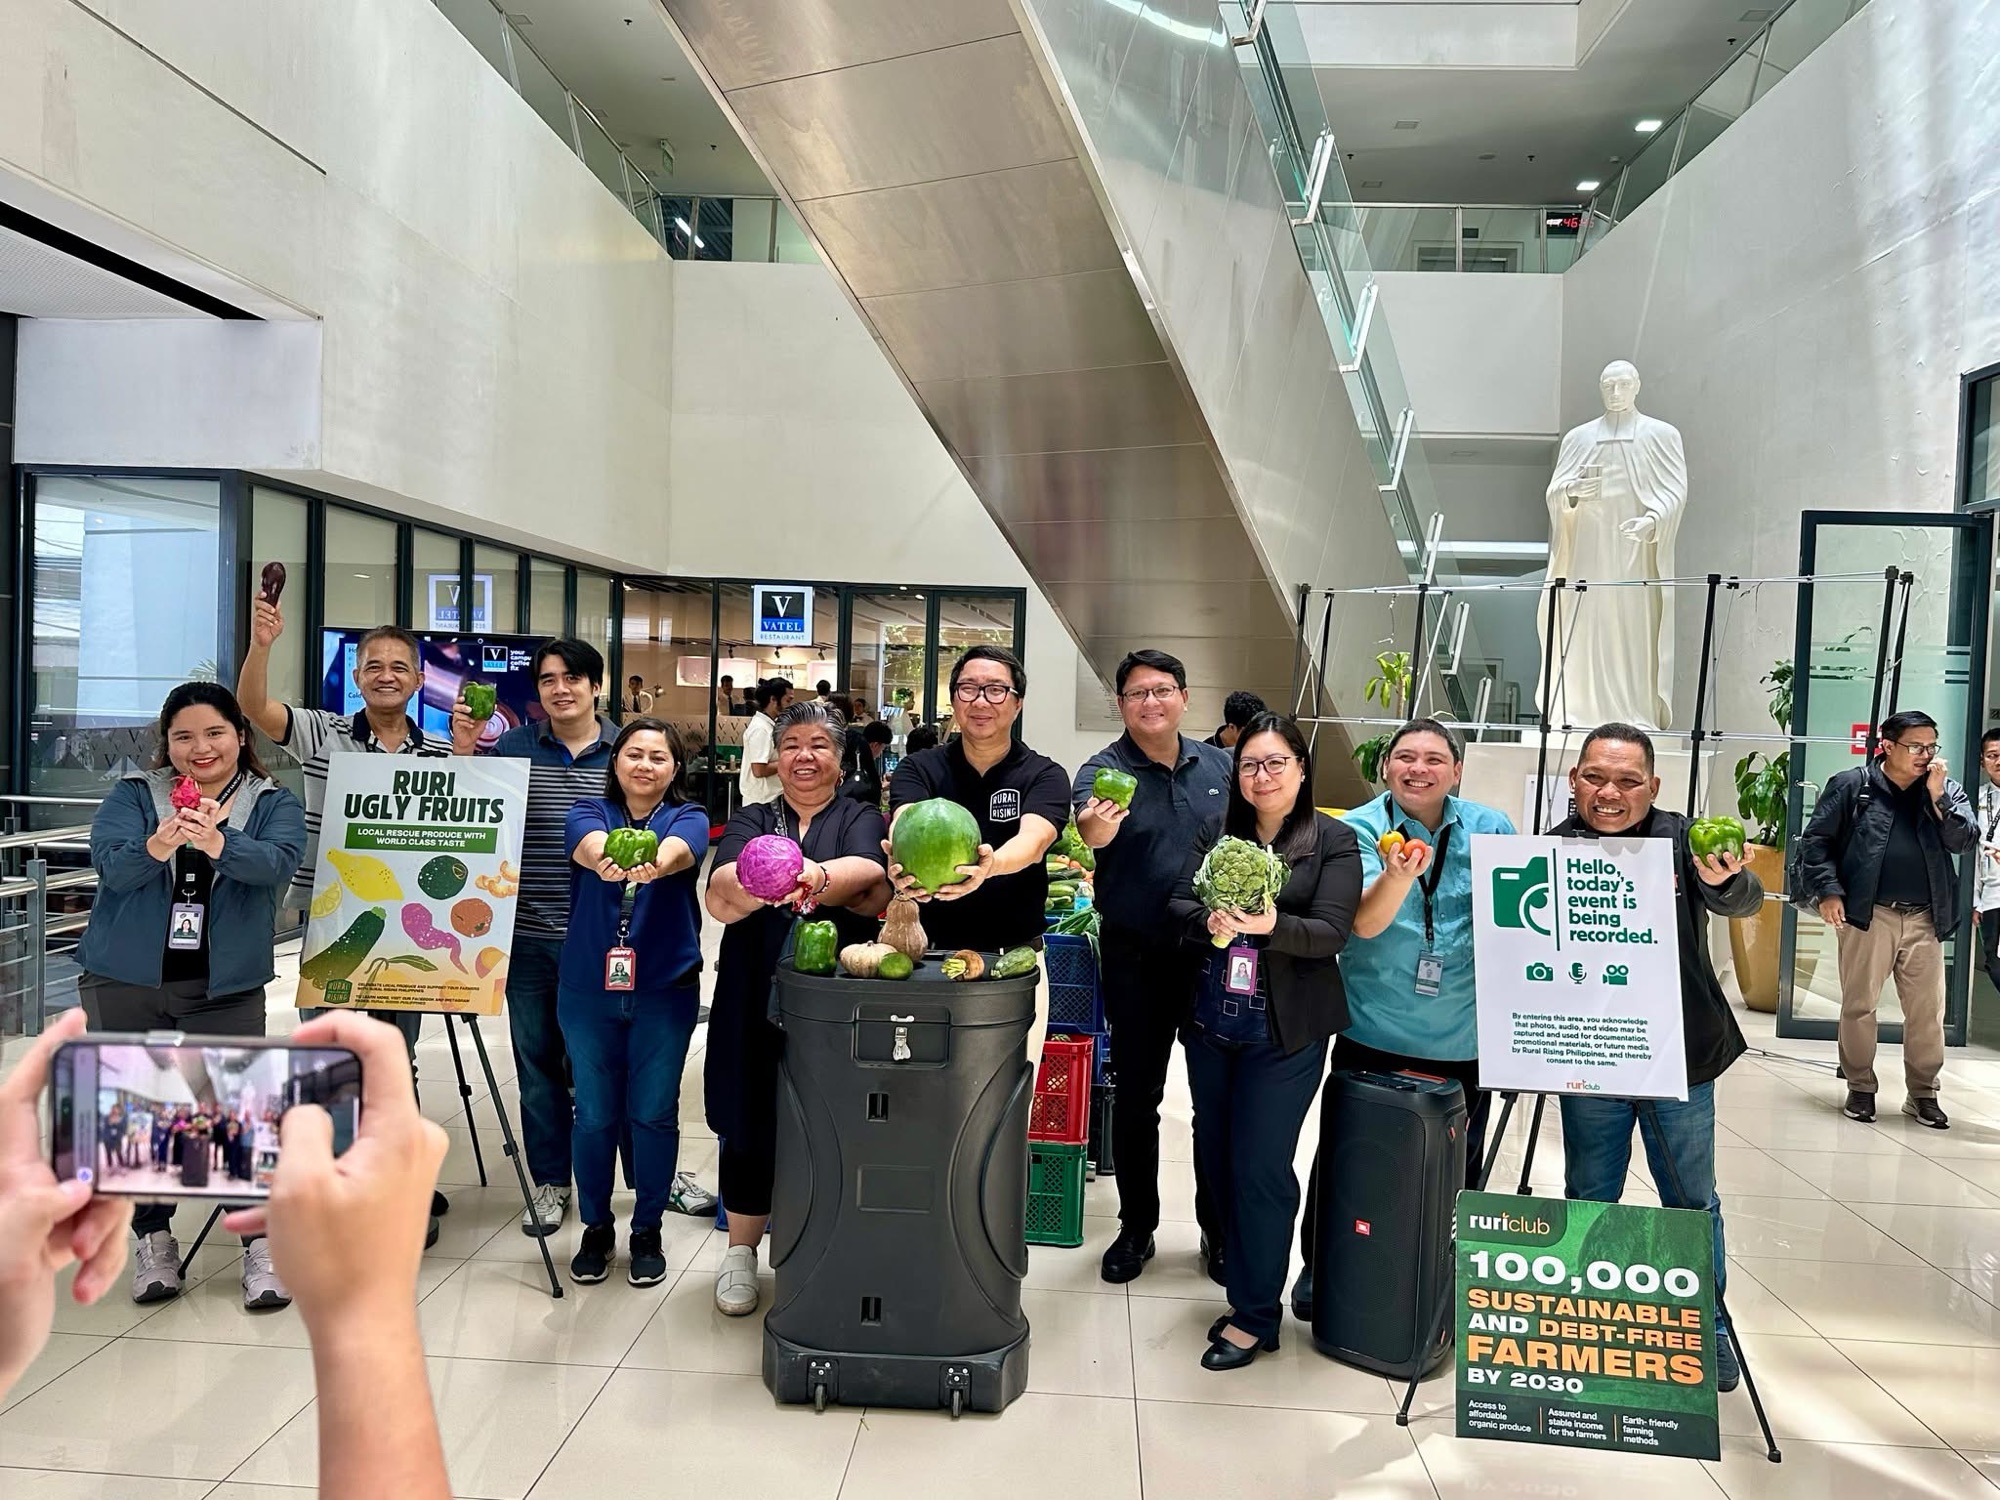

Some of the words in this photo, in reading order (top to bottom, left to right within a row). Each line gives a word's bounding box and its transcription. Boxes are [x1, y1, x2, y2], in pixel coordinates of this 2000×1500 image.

[771, 595, 793, 618] V
[763, 621, 801, 631] VATEL
[490, 648, 501, 660] V
[393, 770, 456, 797] RURI
[993, 793, 1016, 804] RURAL
[344, 794, 411, 820] UGLY
[417, 796, 504, 824] FRUITS
[993, 808, 1016, 818] RISING
[357, 828, 385, 837] LOCAL
[386, 829, 420, 838] RESCUE
[421, 830, 462, 839] PRODUCE
[463, 831, 487, 840] WITH
[376, 837, 407, 845] WORLD
[408, 838, 437, 847] CLASS
[437, 839, 466, 848] TASTE
[1567, 858, 1621, 878] Hello,
[1567, 876, 1635, 894] today's
[1568, 895, 1617, 909] event
[1623, 894, 1637, 909] is
[1569, 909, 1621, 927] being
[1570, 928, 1658, 944] recorded.
[1530, 1022, 1556, 1030] photos,
[1558, 1023, 1581, 1031] audio,
[1602, 1017, 1648, 1026] acknowledge
[1513, 1030, 1544, 1038] captured
[1593, 1034, 1648, 1043] documentation,
[1558, 1041, 1593, 1049] materials,
[1603, 1042, 1625, 1050] future
[1543, 1048, 1564, 1056] Rising
[1565, 1049, 1607, 1058] Philippines,
[1625, 1052, 1652, 1060] thereby
[1469, 1212, 1550, 1235] ruriclub
[1470, 1250, 1700, 1297] 100,000
[1467, 1288, 1701, 1329] SUSTAINABLE
[1468, 1313, 1529, 1334] AND
[1539, 1319, 1702, 1351] DEBT-FREE
[1467, 1334, 1704, 1385] FARMERS
[1467, 1367, 1502, 1385] BY
[1510, 1372, 1584, 1394] 2030
[1468, 1400, 1497, 1411] Access
[1498, 1403, 1507, 1411] to
[1468, 1410, 1508, 1420] affordable
[1548, 1408, 1580, 1419] Assured
[1582, 1412, 1597, 1421] and
[1468, 1420, 1498, 1430] organic
[1499, 1423, 1532, 1434] produce
[1548, 1417, 1572, 1427] stable
[1574, 1421, 1604, 1431] income
[1622, 1415, 1648, 1426] Earth-
[1648, 1418, 1679, 1430] friendly
[1548, 1427, 1560, 1436] for
[1561, 1428, 1575, 1437] the
[1575, 1429, 1607, 1440] farmers
[1622, 1425, 1654, 1437] farming
[1623, 1435, 1659, 1446] methods
